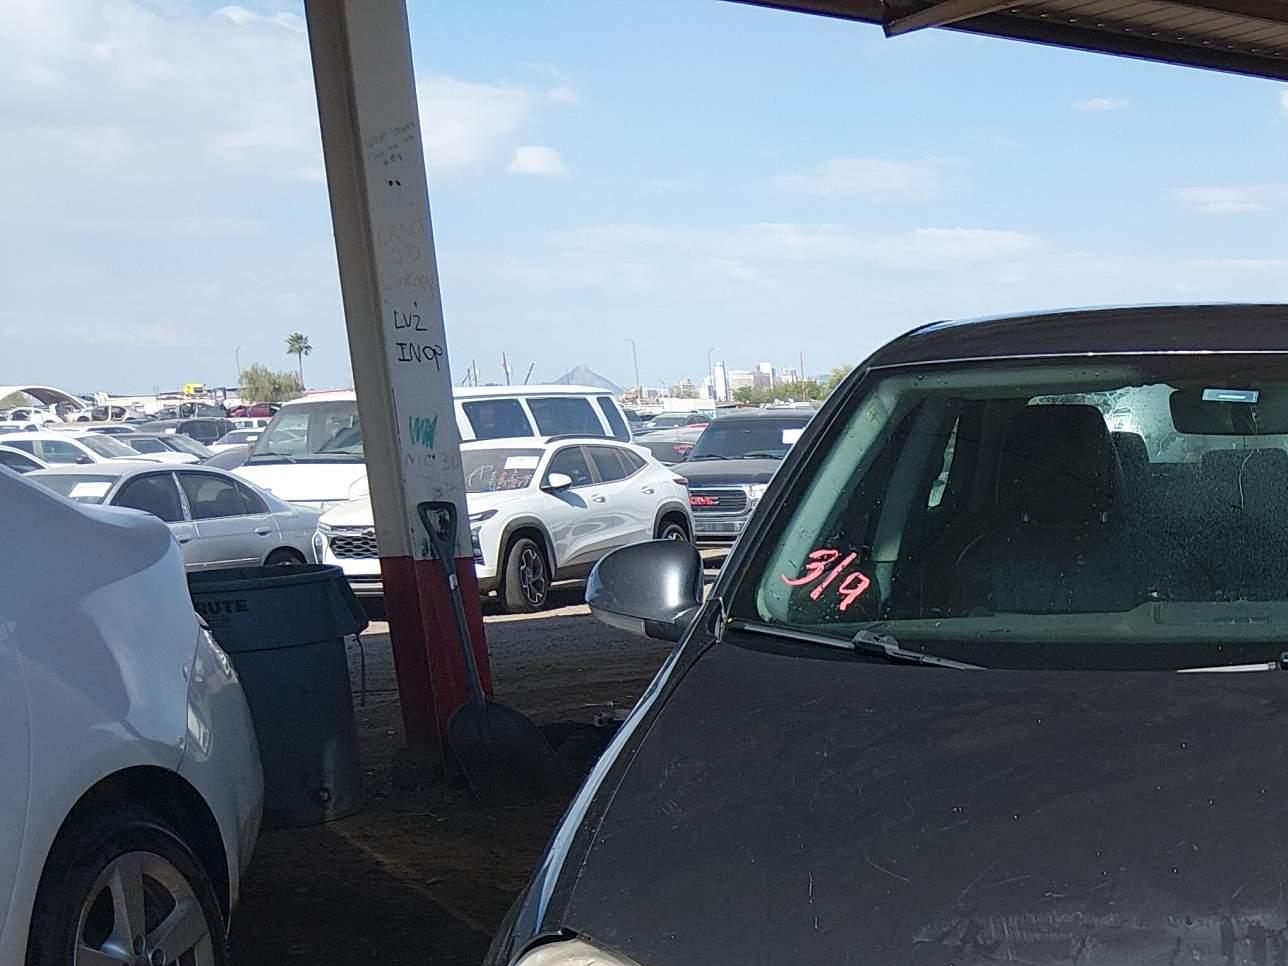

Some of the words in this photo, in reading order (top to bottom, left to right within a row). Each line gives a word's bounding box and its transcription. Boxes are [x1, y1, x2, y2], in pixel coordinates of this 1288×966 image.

[393, 310, 428, 332] LV2
[690, 495, 720, 505] GMC
[781, 549, 871, 611] 3/9
[194, 599, 249, 615] RUTE
